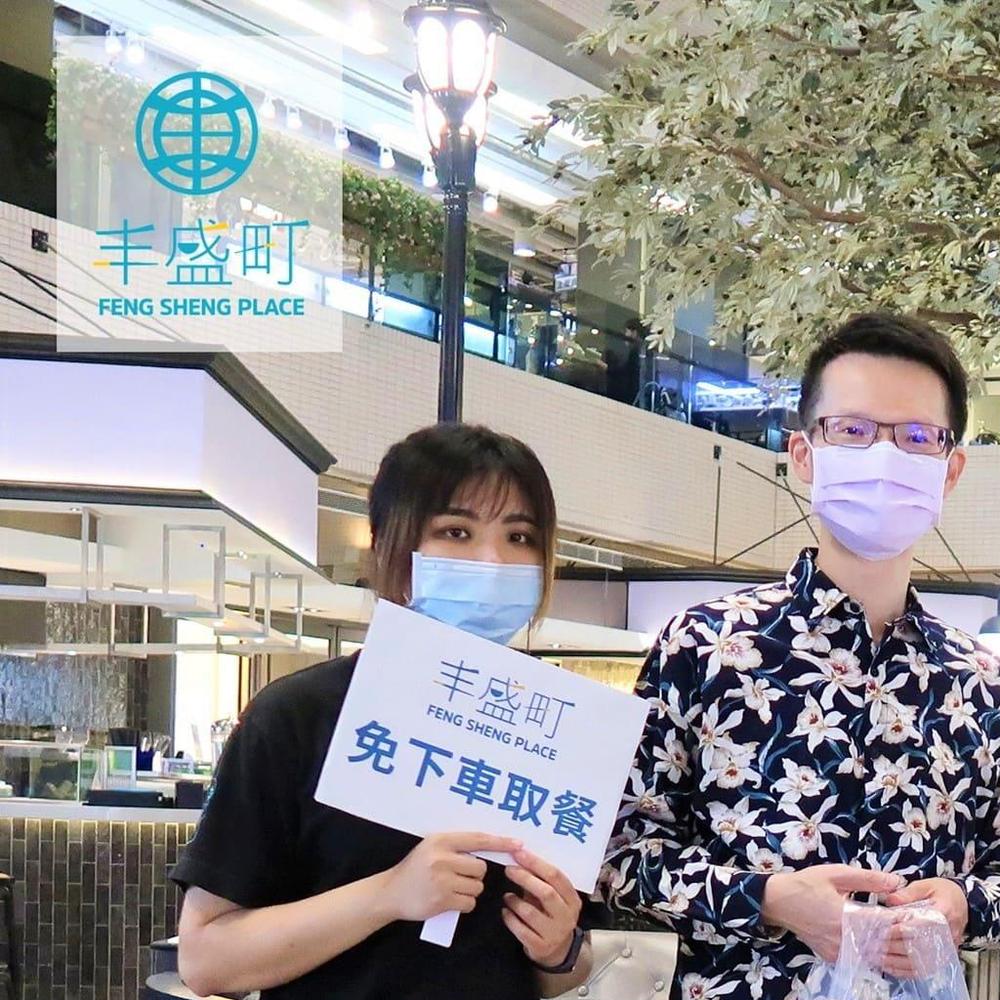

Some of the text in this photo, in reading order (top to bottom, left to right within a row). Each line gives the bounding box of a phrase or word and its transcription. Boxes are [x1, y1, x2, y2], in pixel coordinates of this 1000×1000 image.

[426, 704, 558, 761] FENG SHENG PLACE
[433, 660, 576, 740] 丰盛町
[347, 720, 598, 844] 免下車取餐
